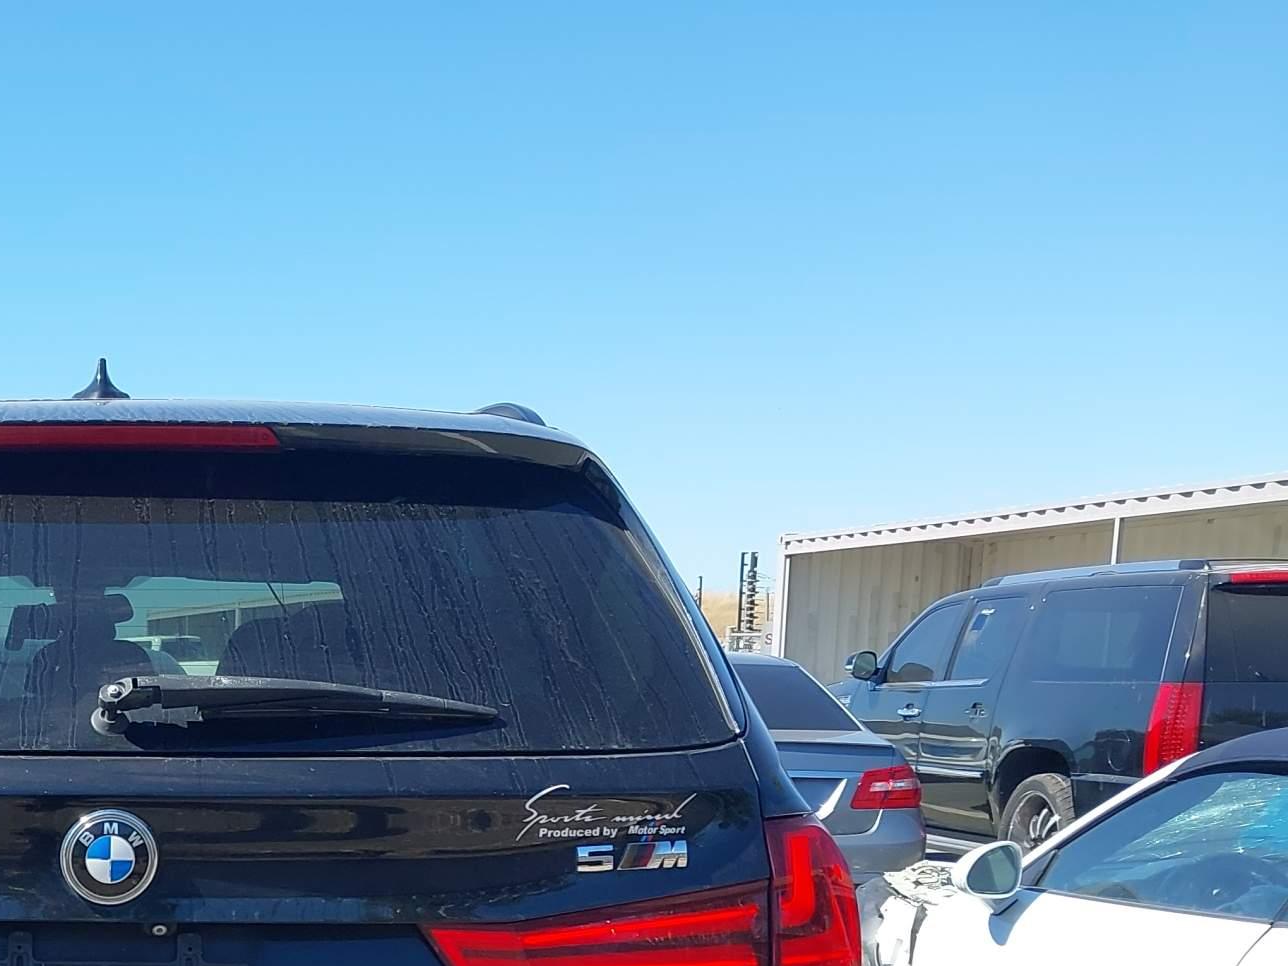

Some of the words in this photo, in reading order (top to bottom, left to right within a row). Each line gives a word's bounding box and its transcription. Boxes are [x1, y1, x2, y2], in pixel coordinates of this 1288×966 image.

[78, 822, 144, 848] BMW
[538, 826, 600, 838] Produced
[602, 827, 618, 839] by
[627, 824, 659, 835] Motor
[659, 825, 686, 835] Sport
[576, 844, 614, 873] 5
